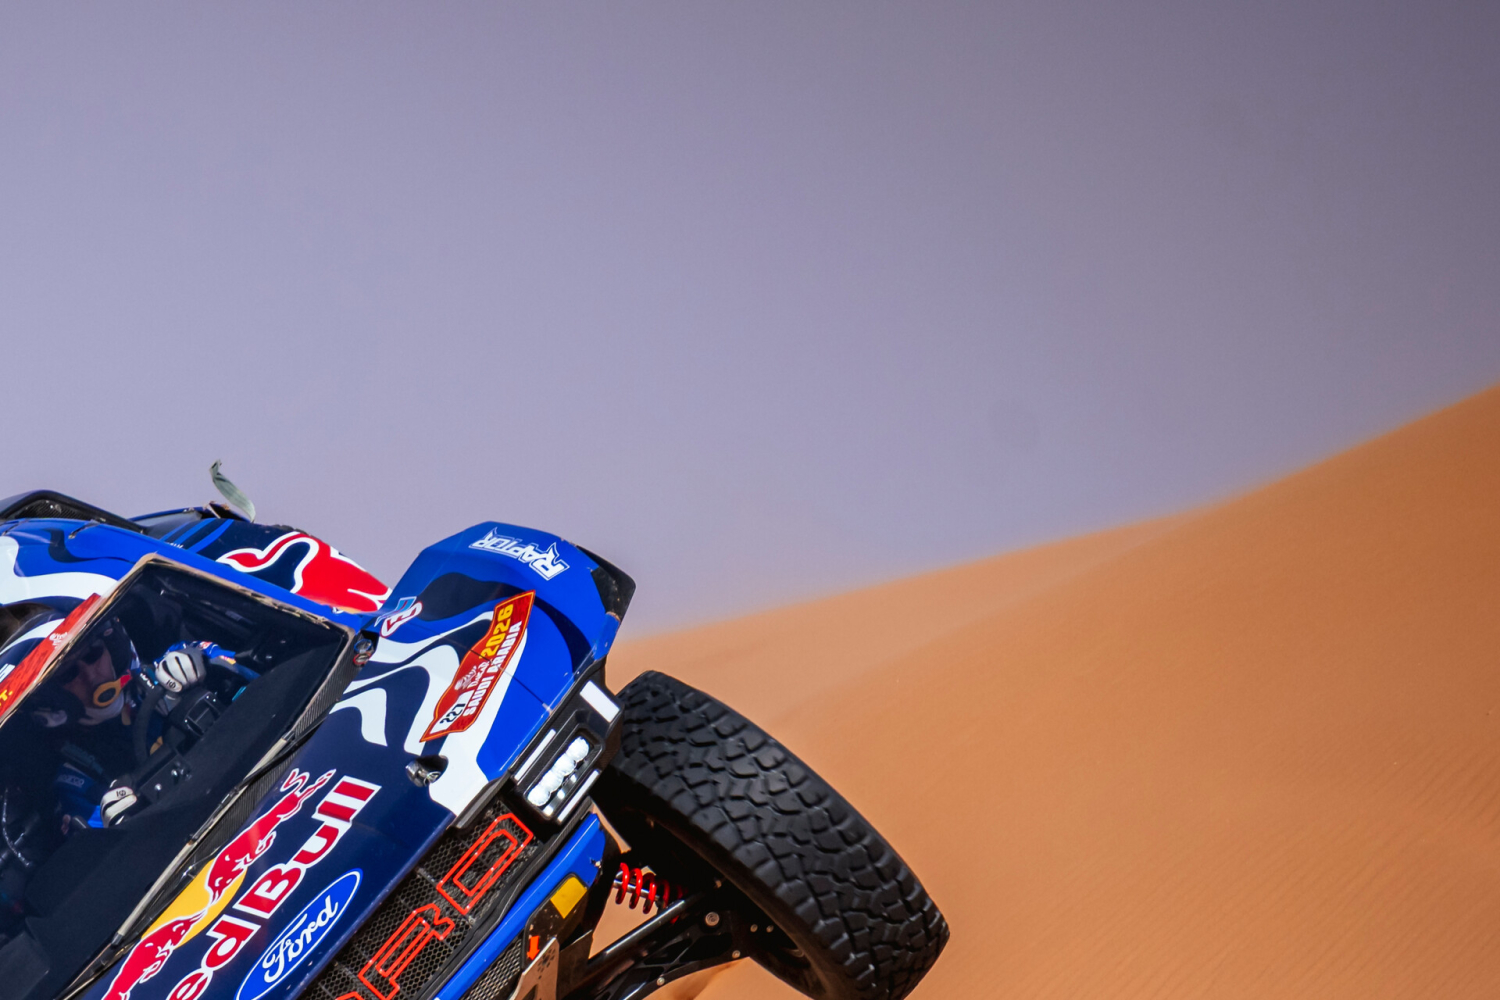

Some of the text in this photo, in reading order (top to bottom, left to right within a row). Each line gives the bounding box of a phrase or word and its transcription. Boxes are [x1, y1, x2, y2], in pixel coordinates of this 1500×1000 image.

[469, 527, 570, 581] RAPTOR
[479, 603, 514, 660] 2026
[462, 620, 523, 717] SAUDI ARABIA
[439, 702, 467, 724] 227
[232, 775, 382, 919] Bull
[261, 896, 339, 984] Ford
